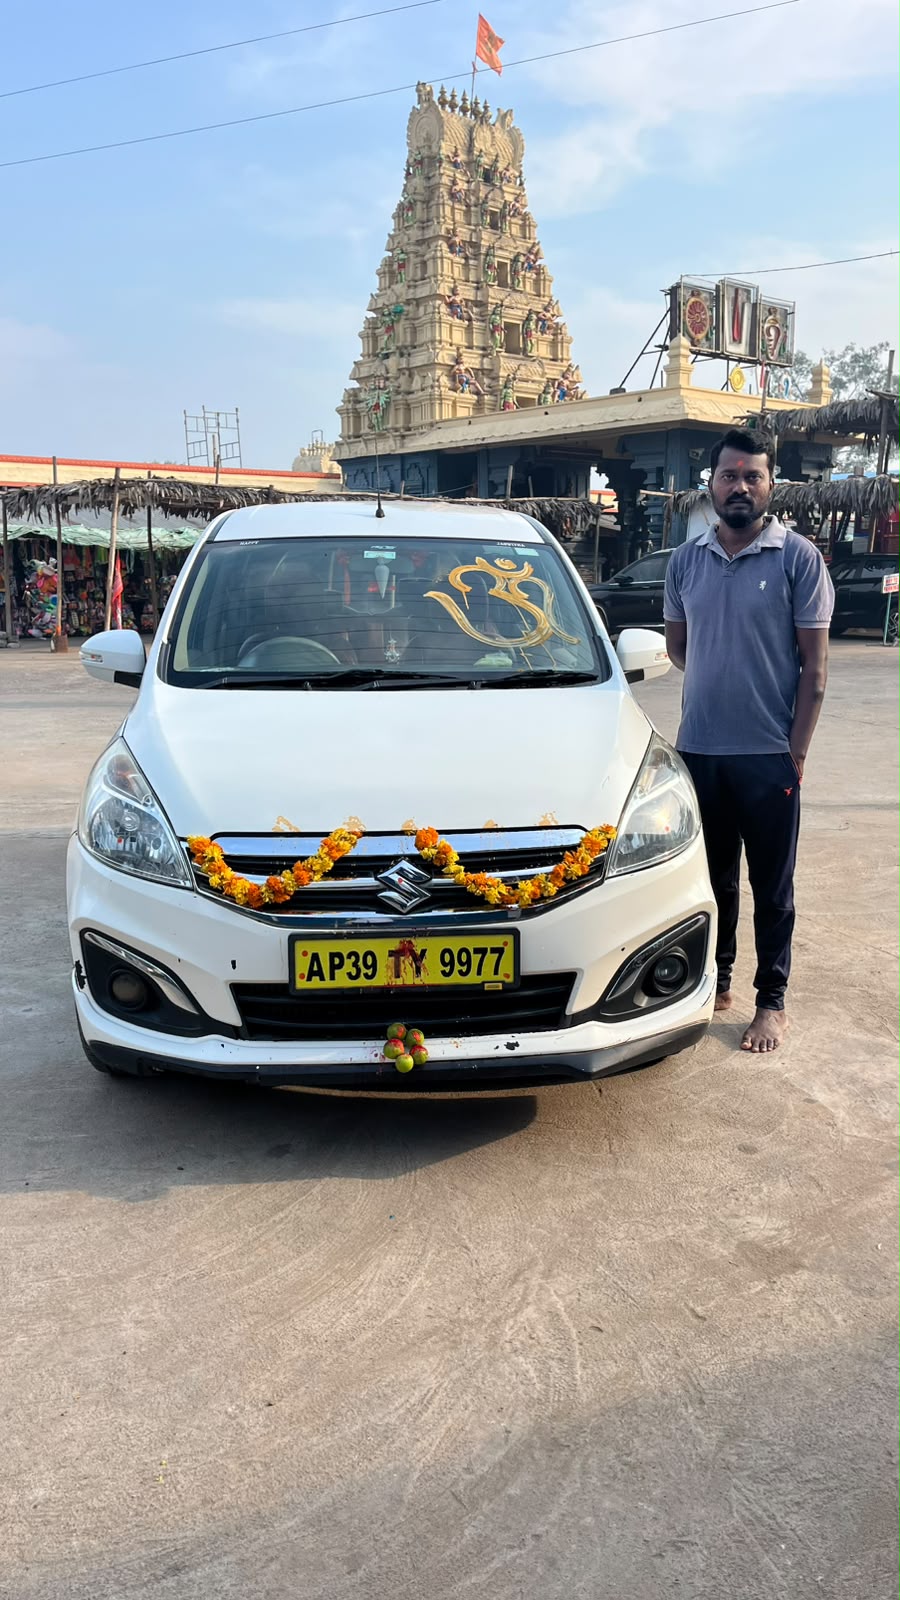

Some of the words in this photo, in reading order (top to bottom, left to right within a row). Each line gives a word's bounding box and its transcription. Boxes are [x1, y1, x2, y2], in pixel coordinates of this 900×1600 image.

[306, 949, 378, 983] AP39
[387, 948, 428, 979] TY
[439, 946, 506, 978] 9977
